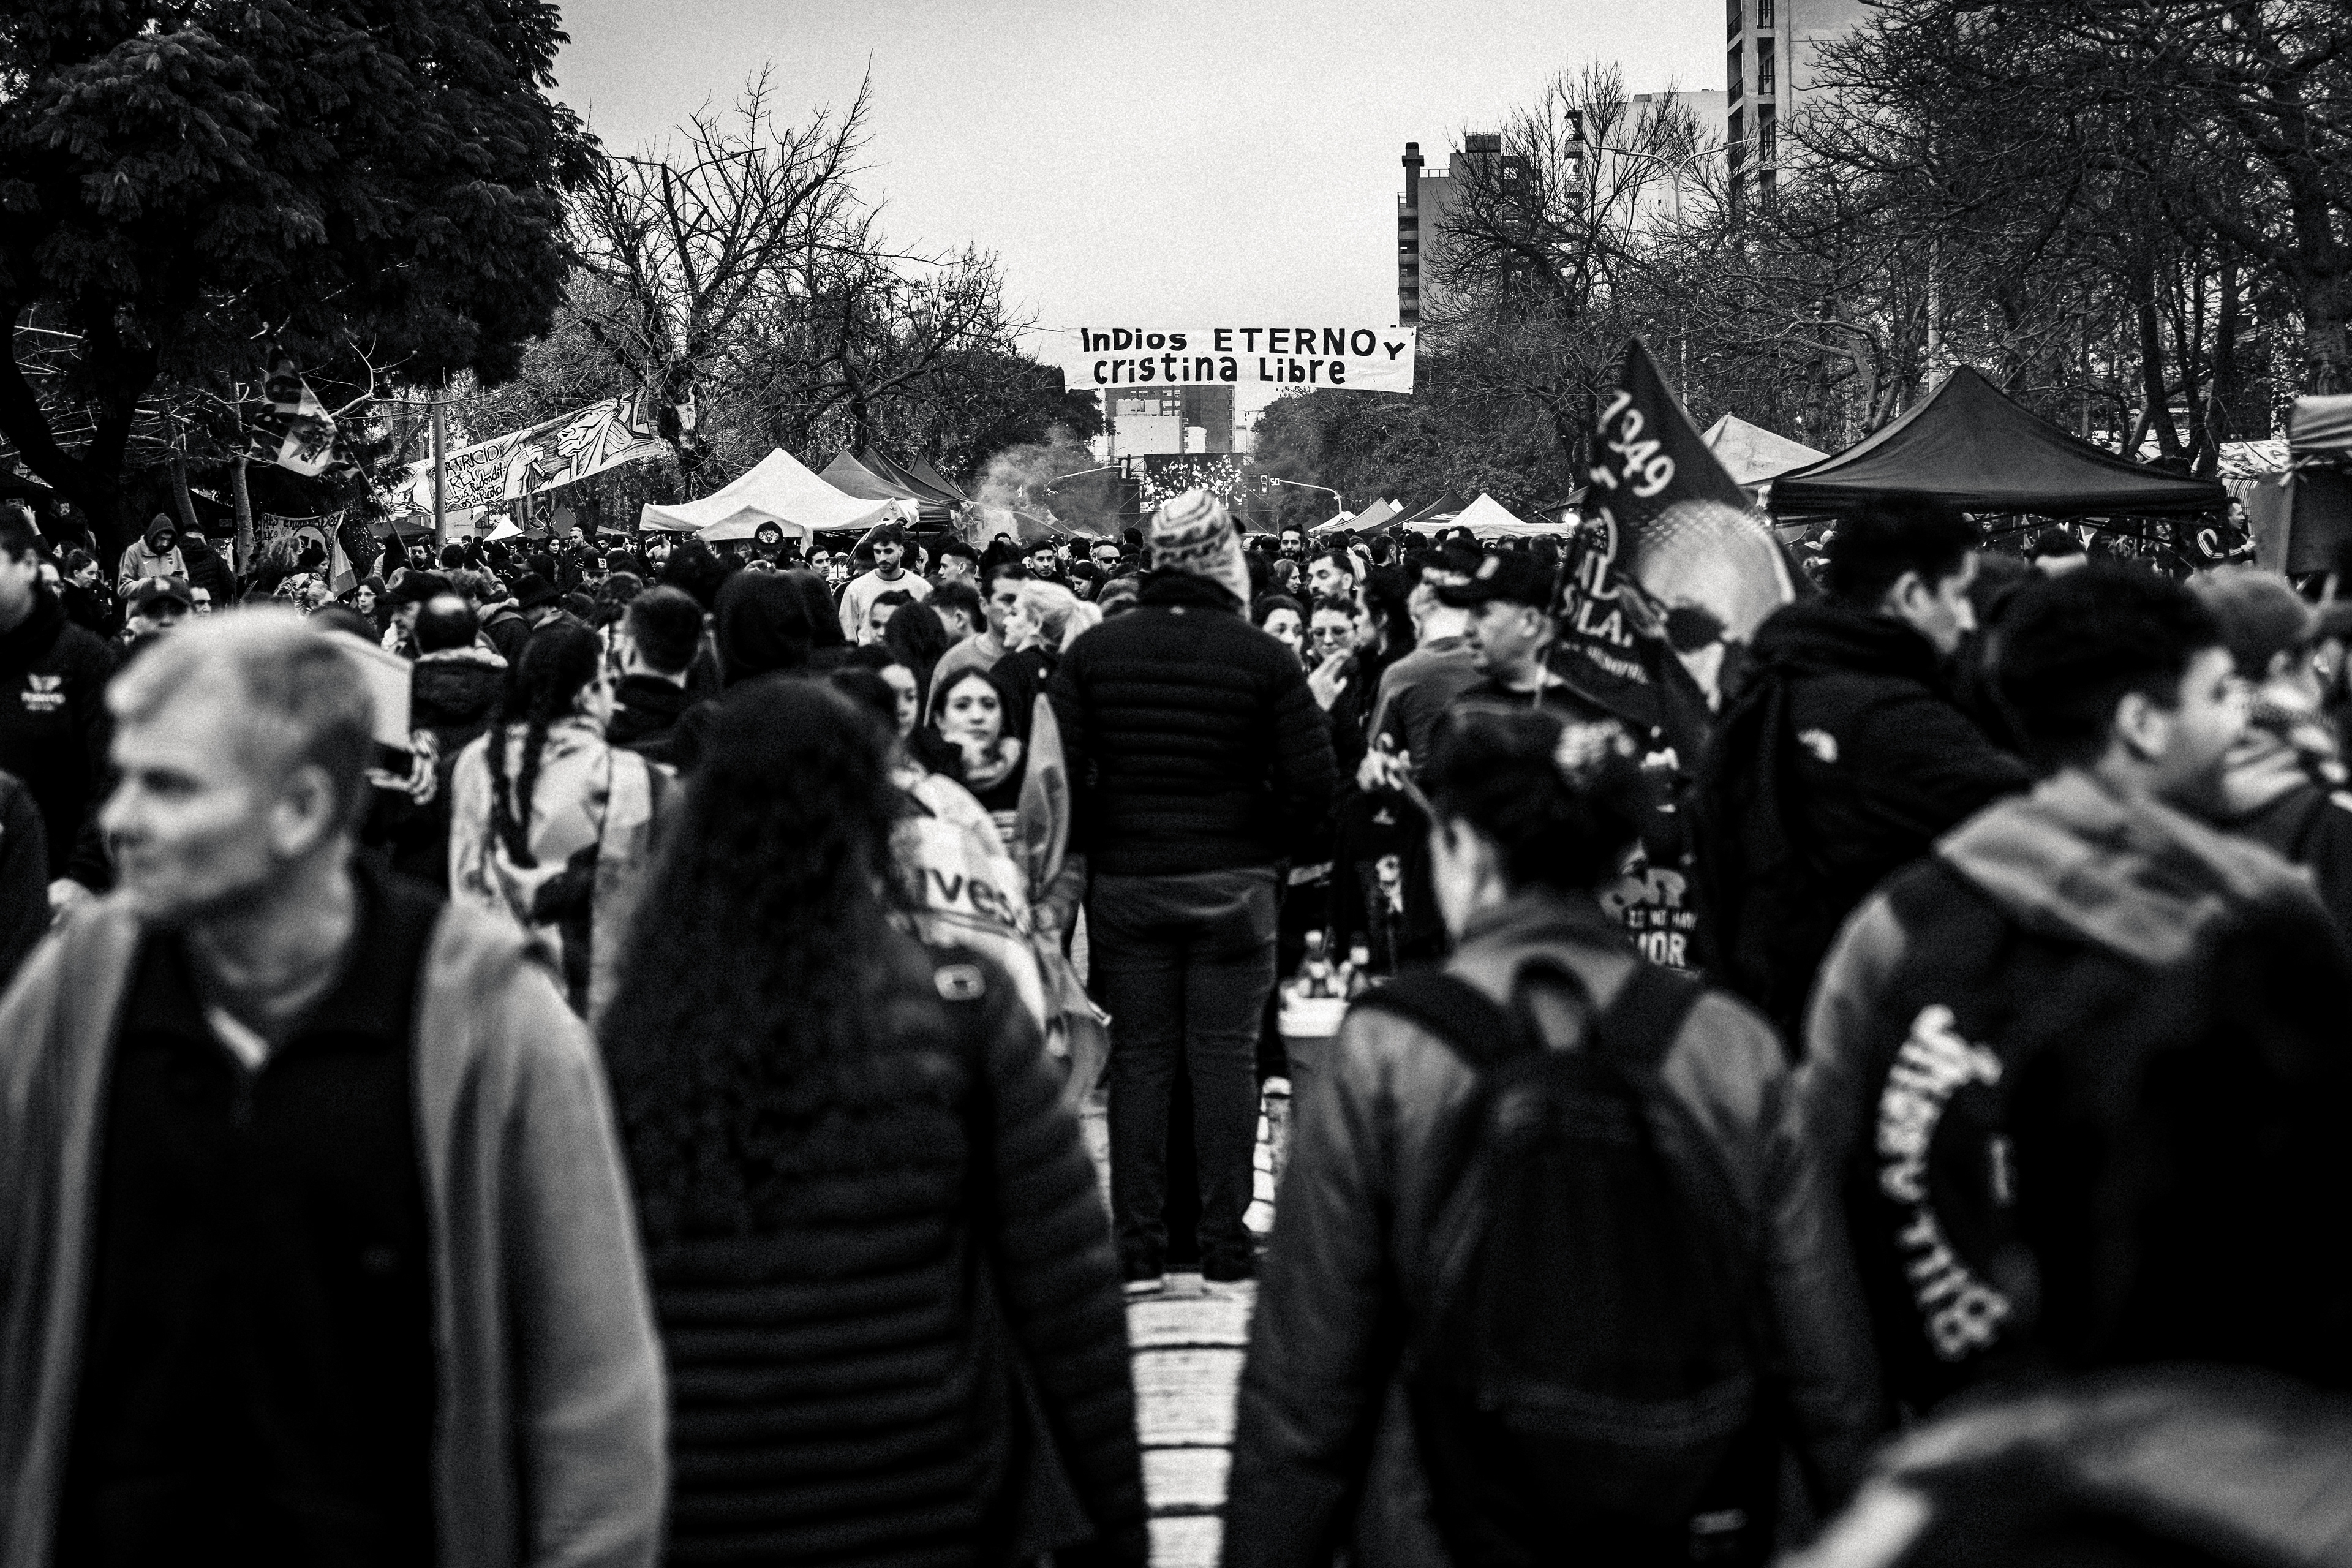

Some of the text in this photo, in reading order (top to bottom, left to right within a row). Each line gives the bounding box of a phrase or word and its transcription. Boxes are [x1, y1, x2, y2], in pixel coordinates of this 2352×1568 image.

[1214, 328, 1376, 356] ETERNO
[1259, 357, 1346, 385] Libre
[445, 446, 499, 478] ATRICIO
